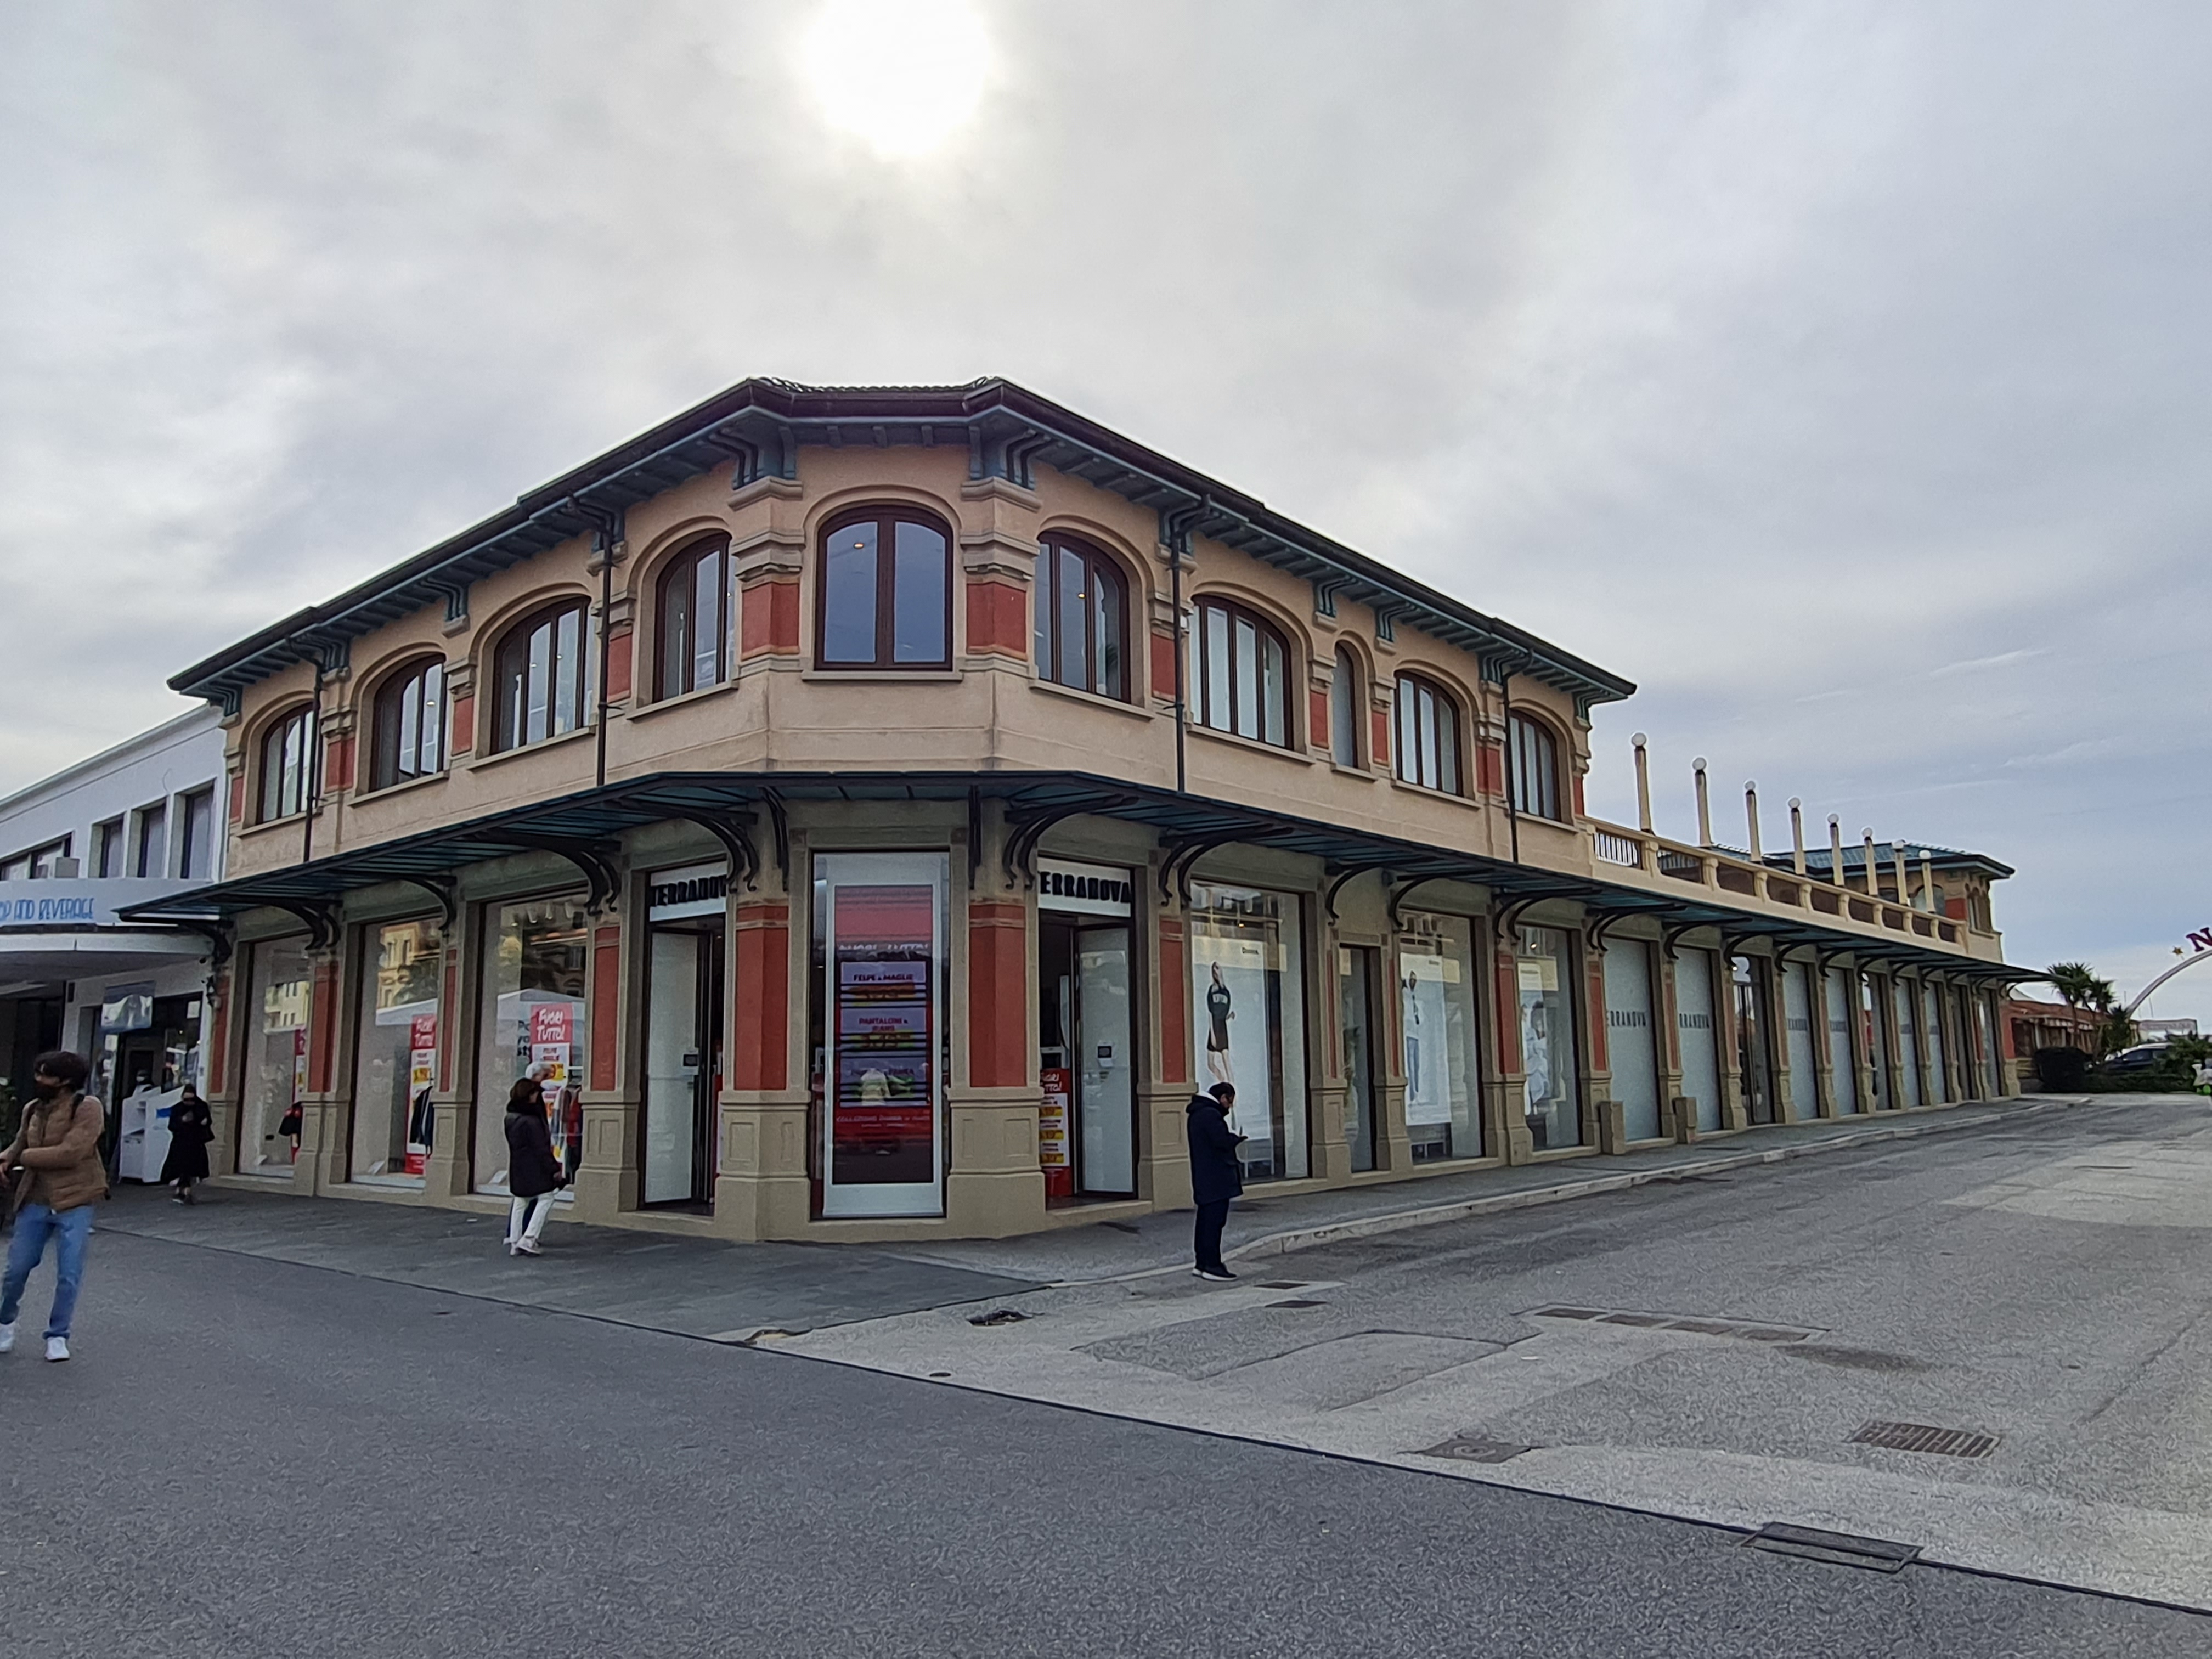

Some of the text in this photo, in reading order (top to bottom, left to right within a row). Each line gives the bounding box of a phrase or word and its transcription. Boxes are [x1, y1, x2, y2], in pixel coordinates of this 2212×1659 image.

[650, 874, 727, 907] TERRANOV
[1037, 871, 1132, 903] ERRANOVA
[1607, 1011, 1646, 1028] RRANOVA
